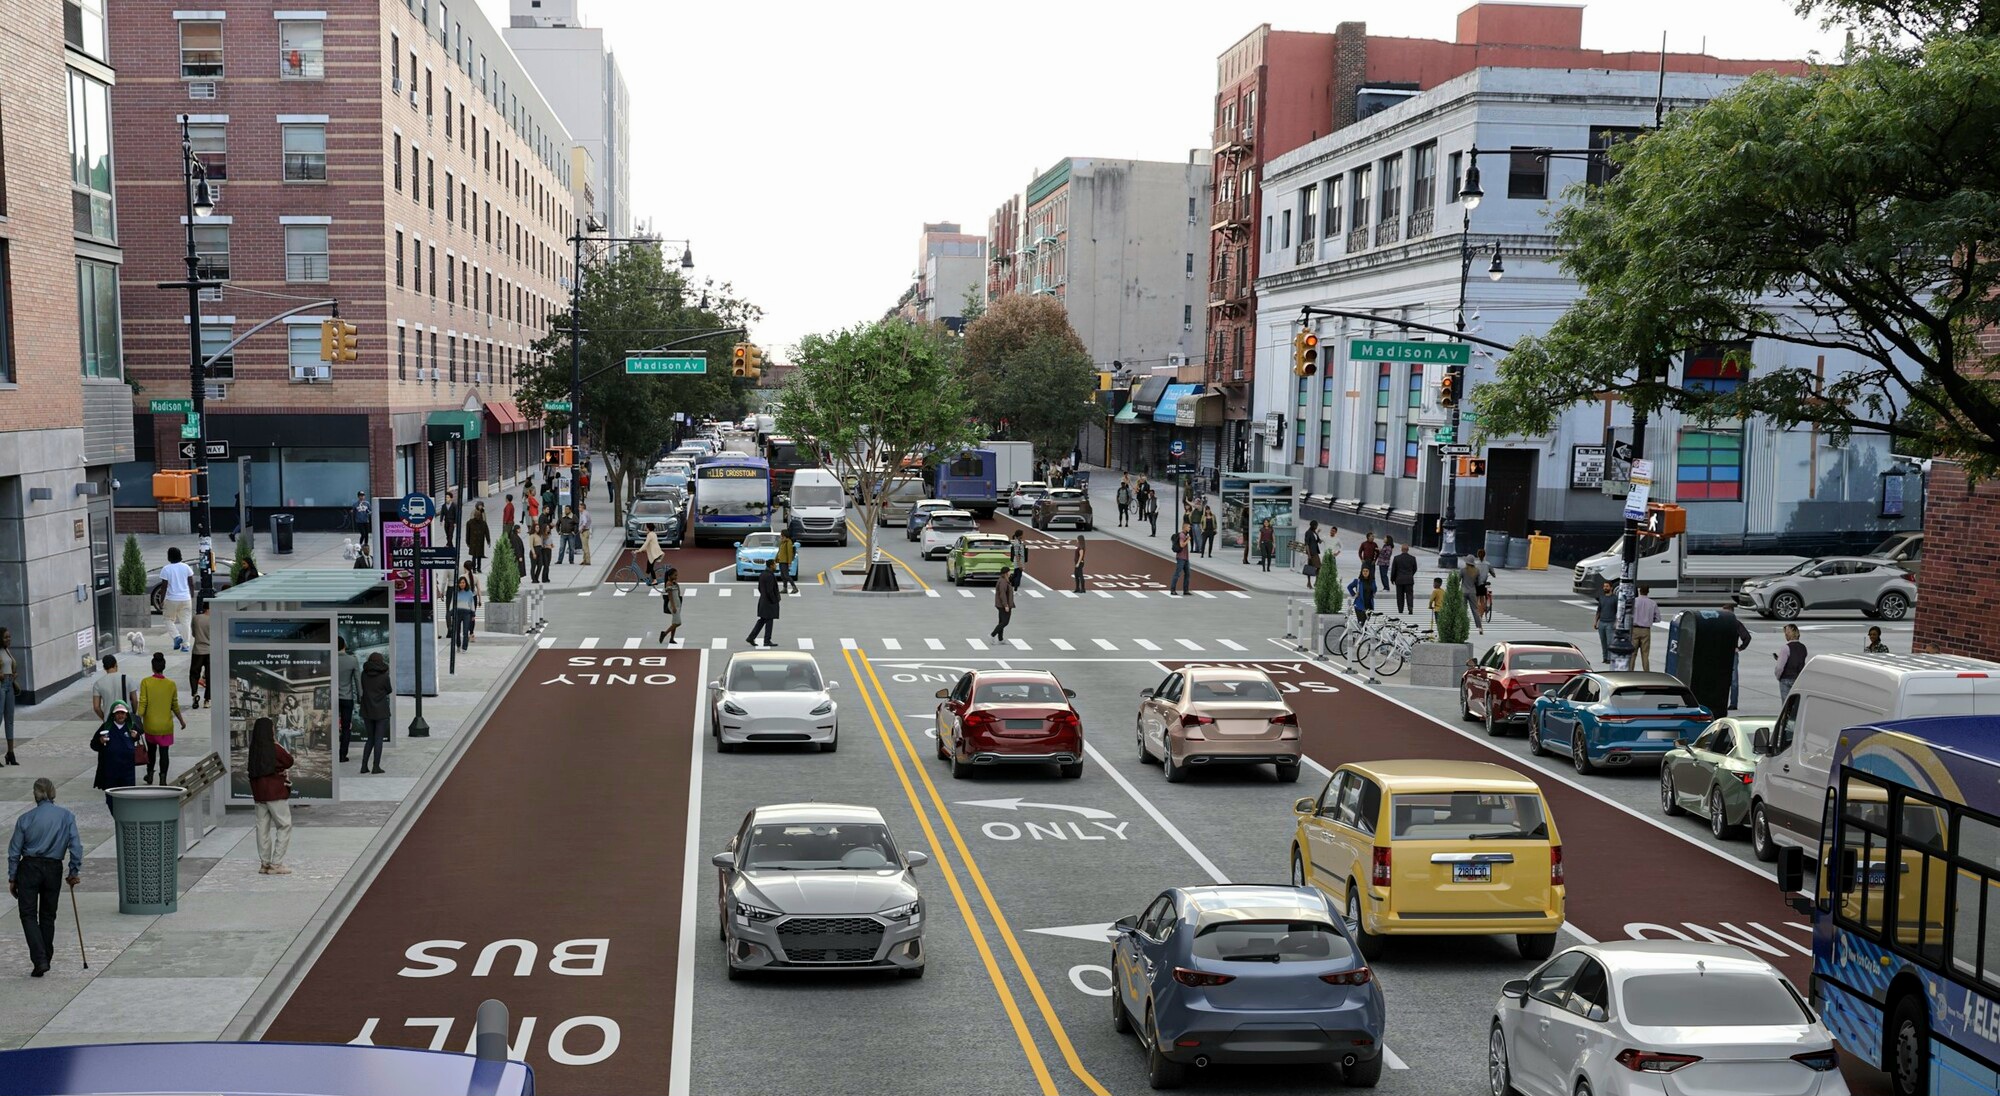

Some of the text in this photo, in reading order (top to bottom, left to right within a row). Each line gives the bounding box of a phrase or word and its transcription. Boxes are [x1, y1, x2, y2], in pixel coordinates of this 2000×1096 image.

[1361, 344, 1459, 360] Madison Av
[634, 361, 698, 370] Madison Av
[151, 401, 182, 411] Madison
[726, 468, 757, 477] CROSSTOWN
[567, 656, 667, 666] BUS
[541, 674, 677, 685] ONLY
[982, 822, 1131, 841] ONLY
[397, 938, 610, 978] BUS
[1857, 953, 1865, 966] York
[1974, 994, 2000, 1044] ELE
